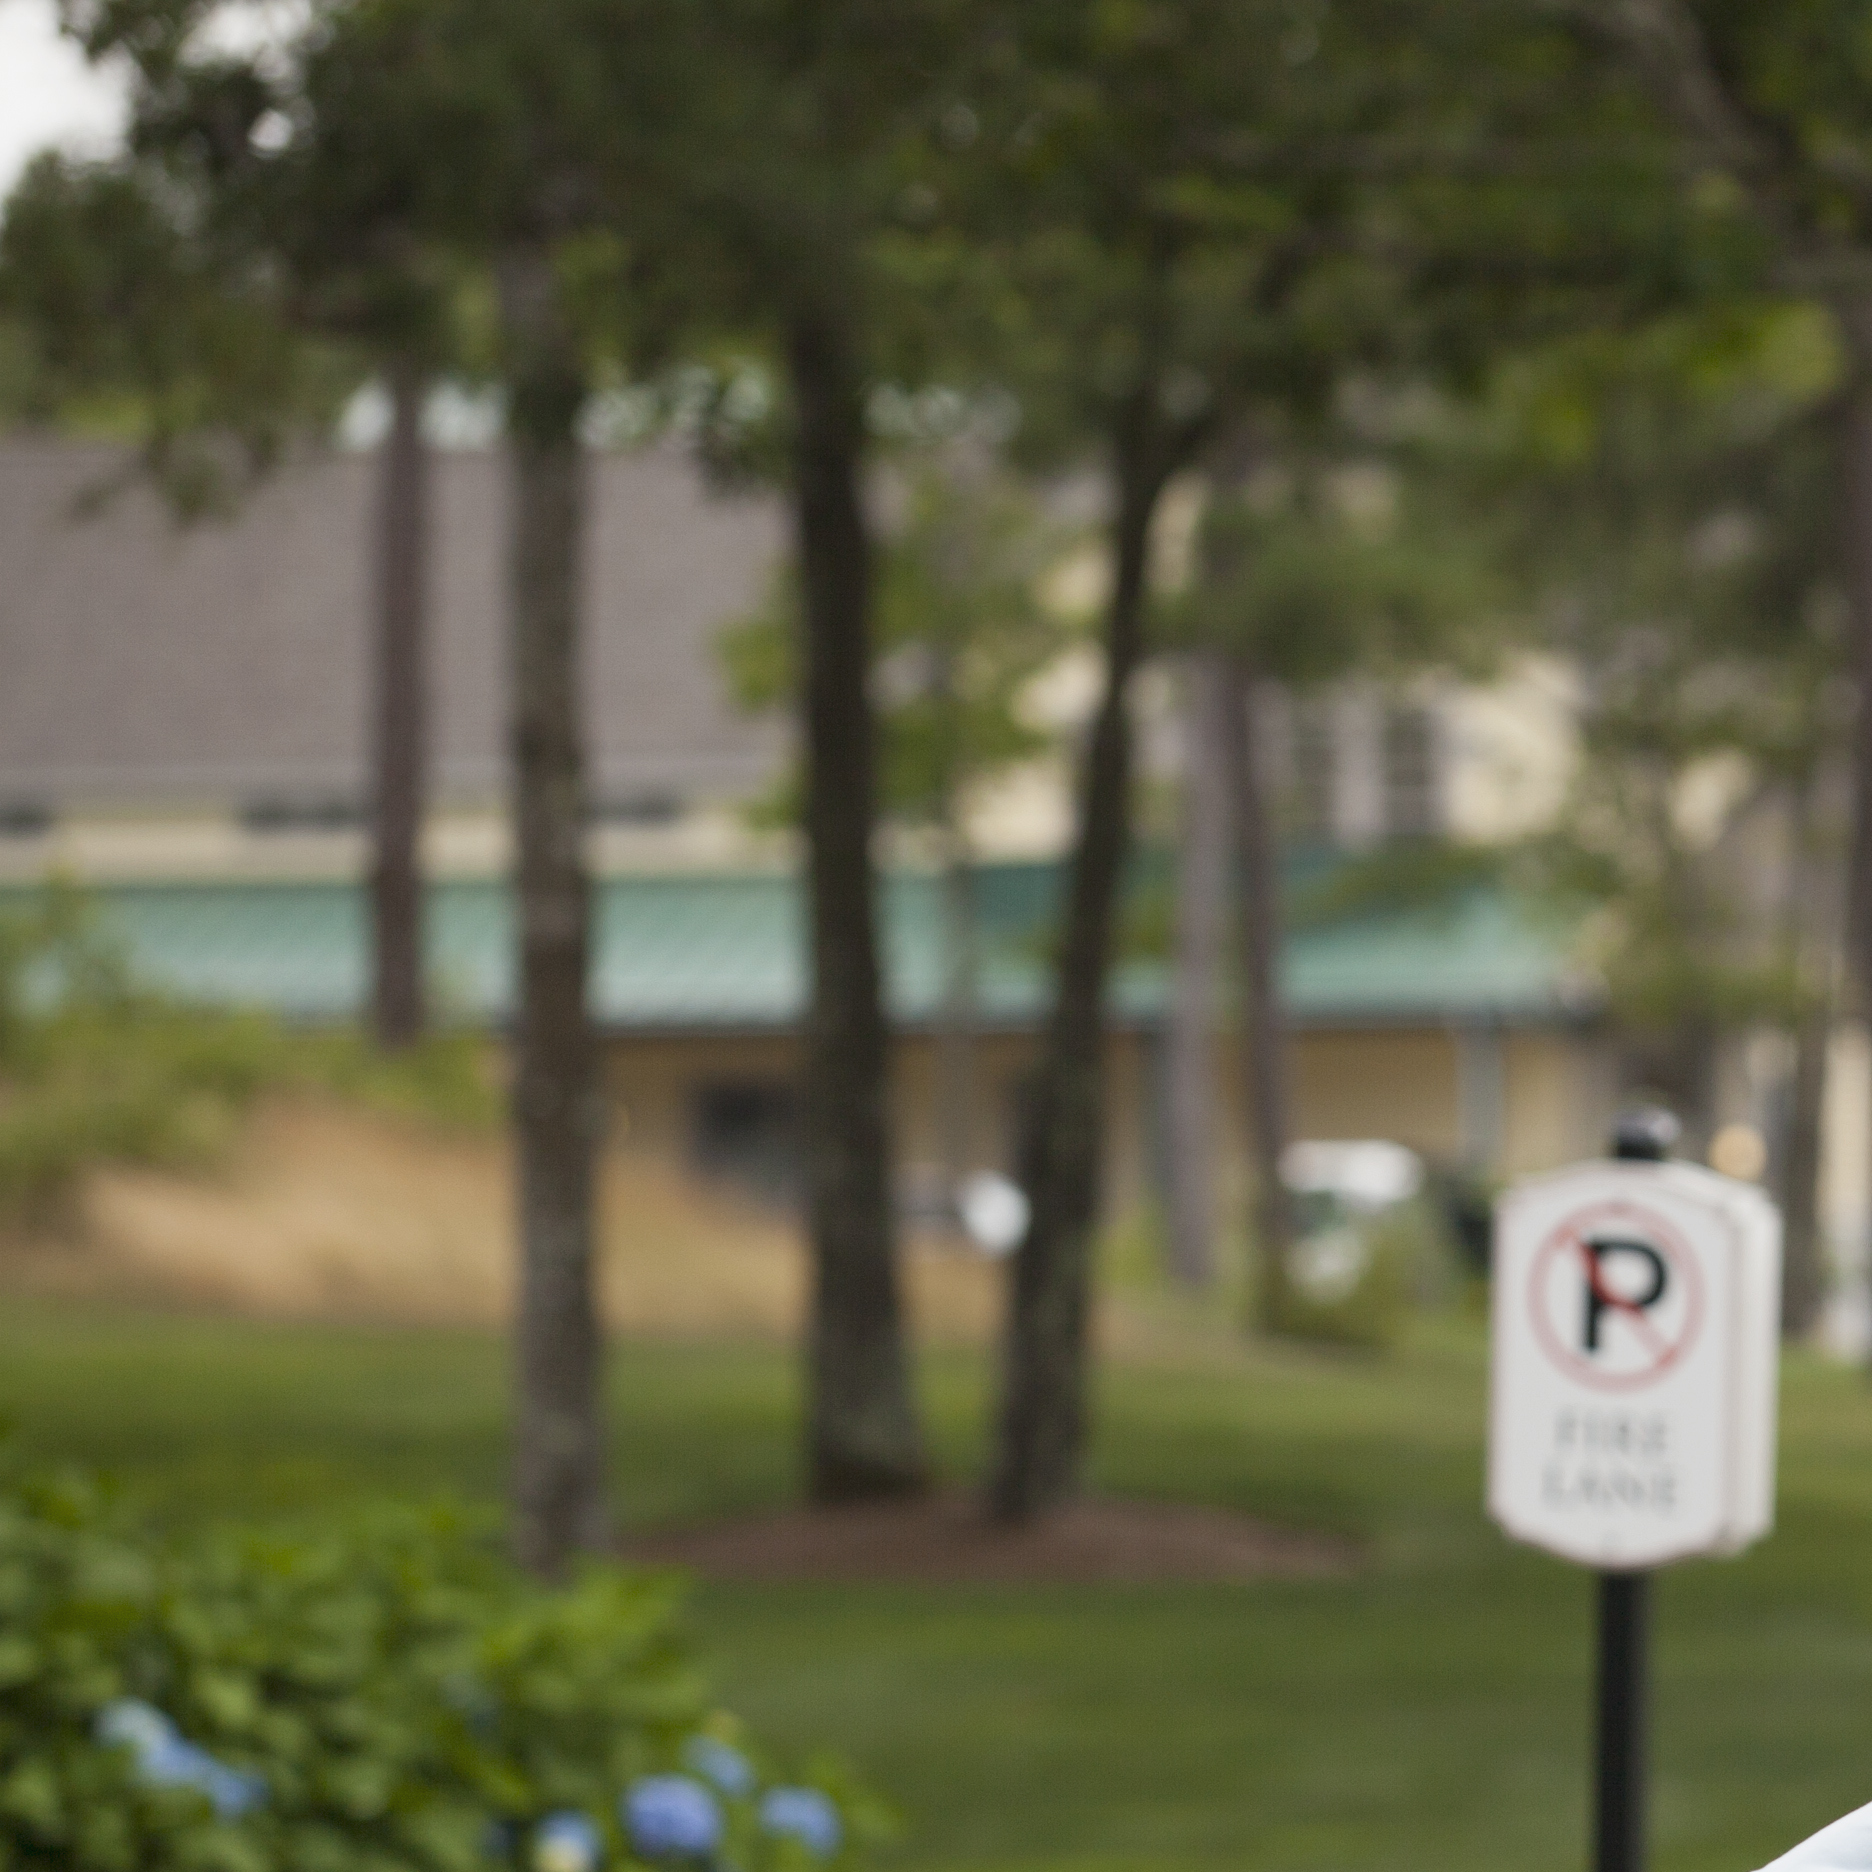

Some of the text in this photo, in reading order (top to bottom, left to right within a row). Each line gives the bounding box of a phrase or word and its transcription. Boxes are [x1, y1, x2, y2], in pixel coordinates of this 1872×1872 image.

[1580, 1237, 1667, 1353] P
[1554, 1409, 1668, 1454] FIRE
[1541, 1464, 1676, 1514] LANE
